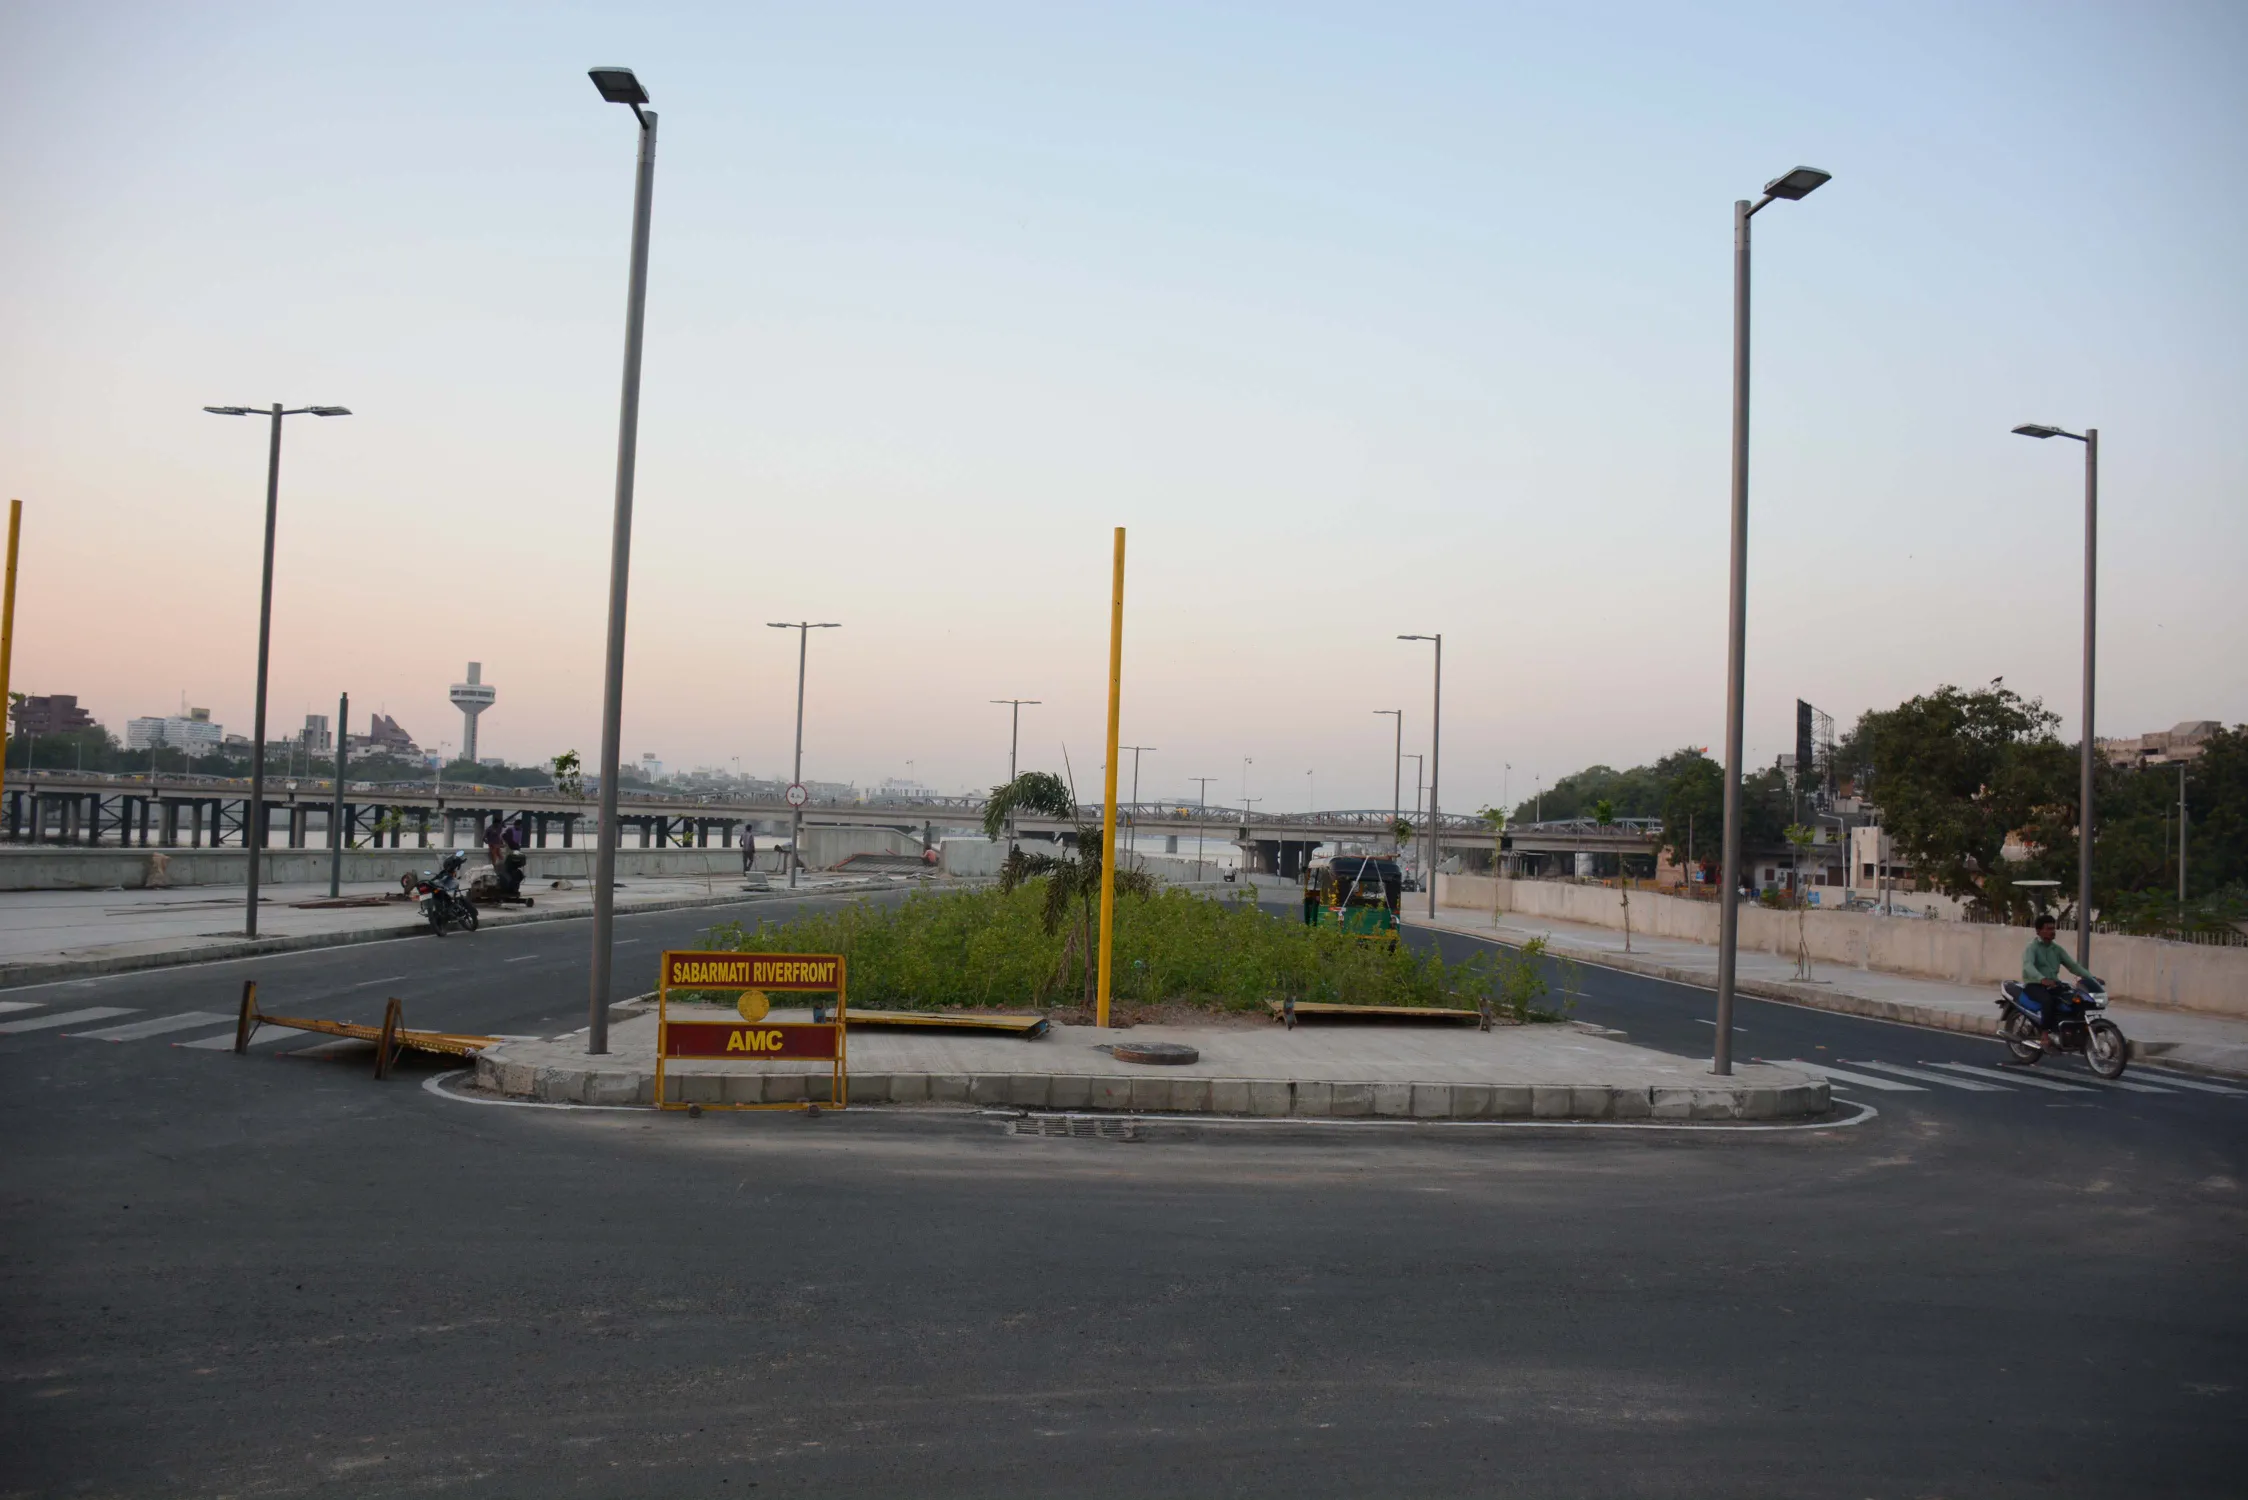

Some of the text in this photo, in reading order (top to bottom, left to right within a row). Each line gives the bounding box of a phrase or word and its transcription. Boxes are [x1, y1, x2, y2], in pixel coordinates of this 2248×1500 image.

[673, 962, 836, 983] SABARMATI RIVERFRONT
[726, 1030, 783, 1051] AMC
